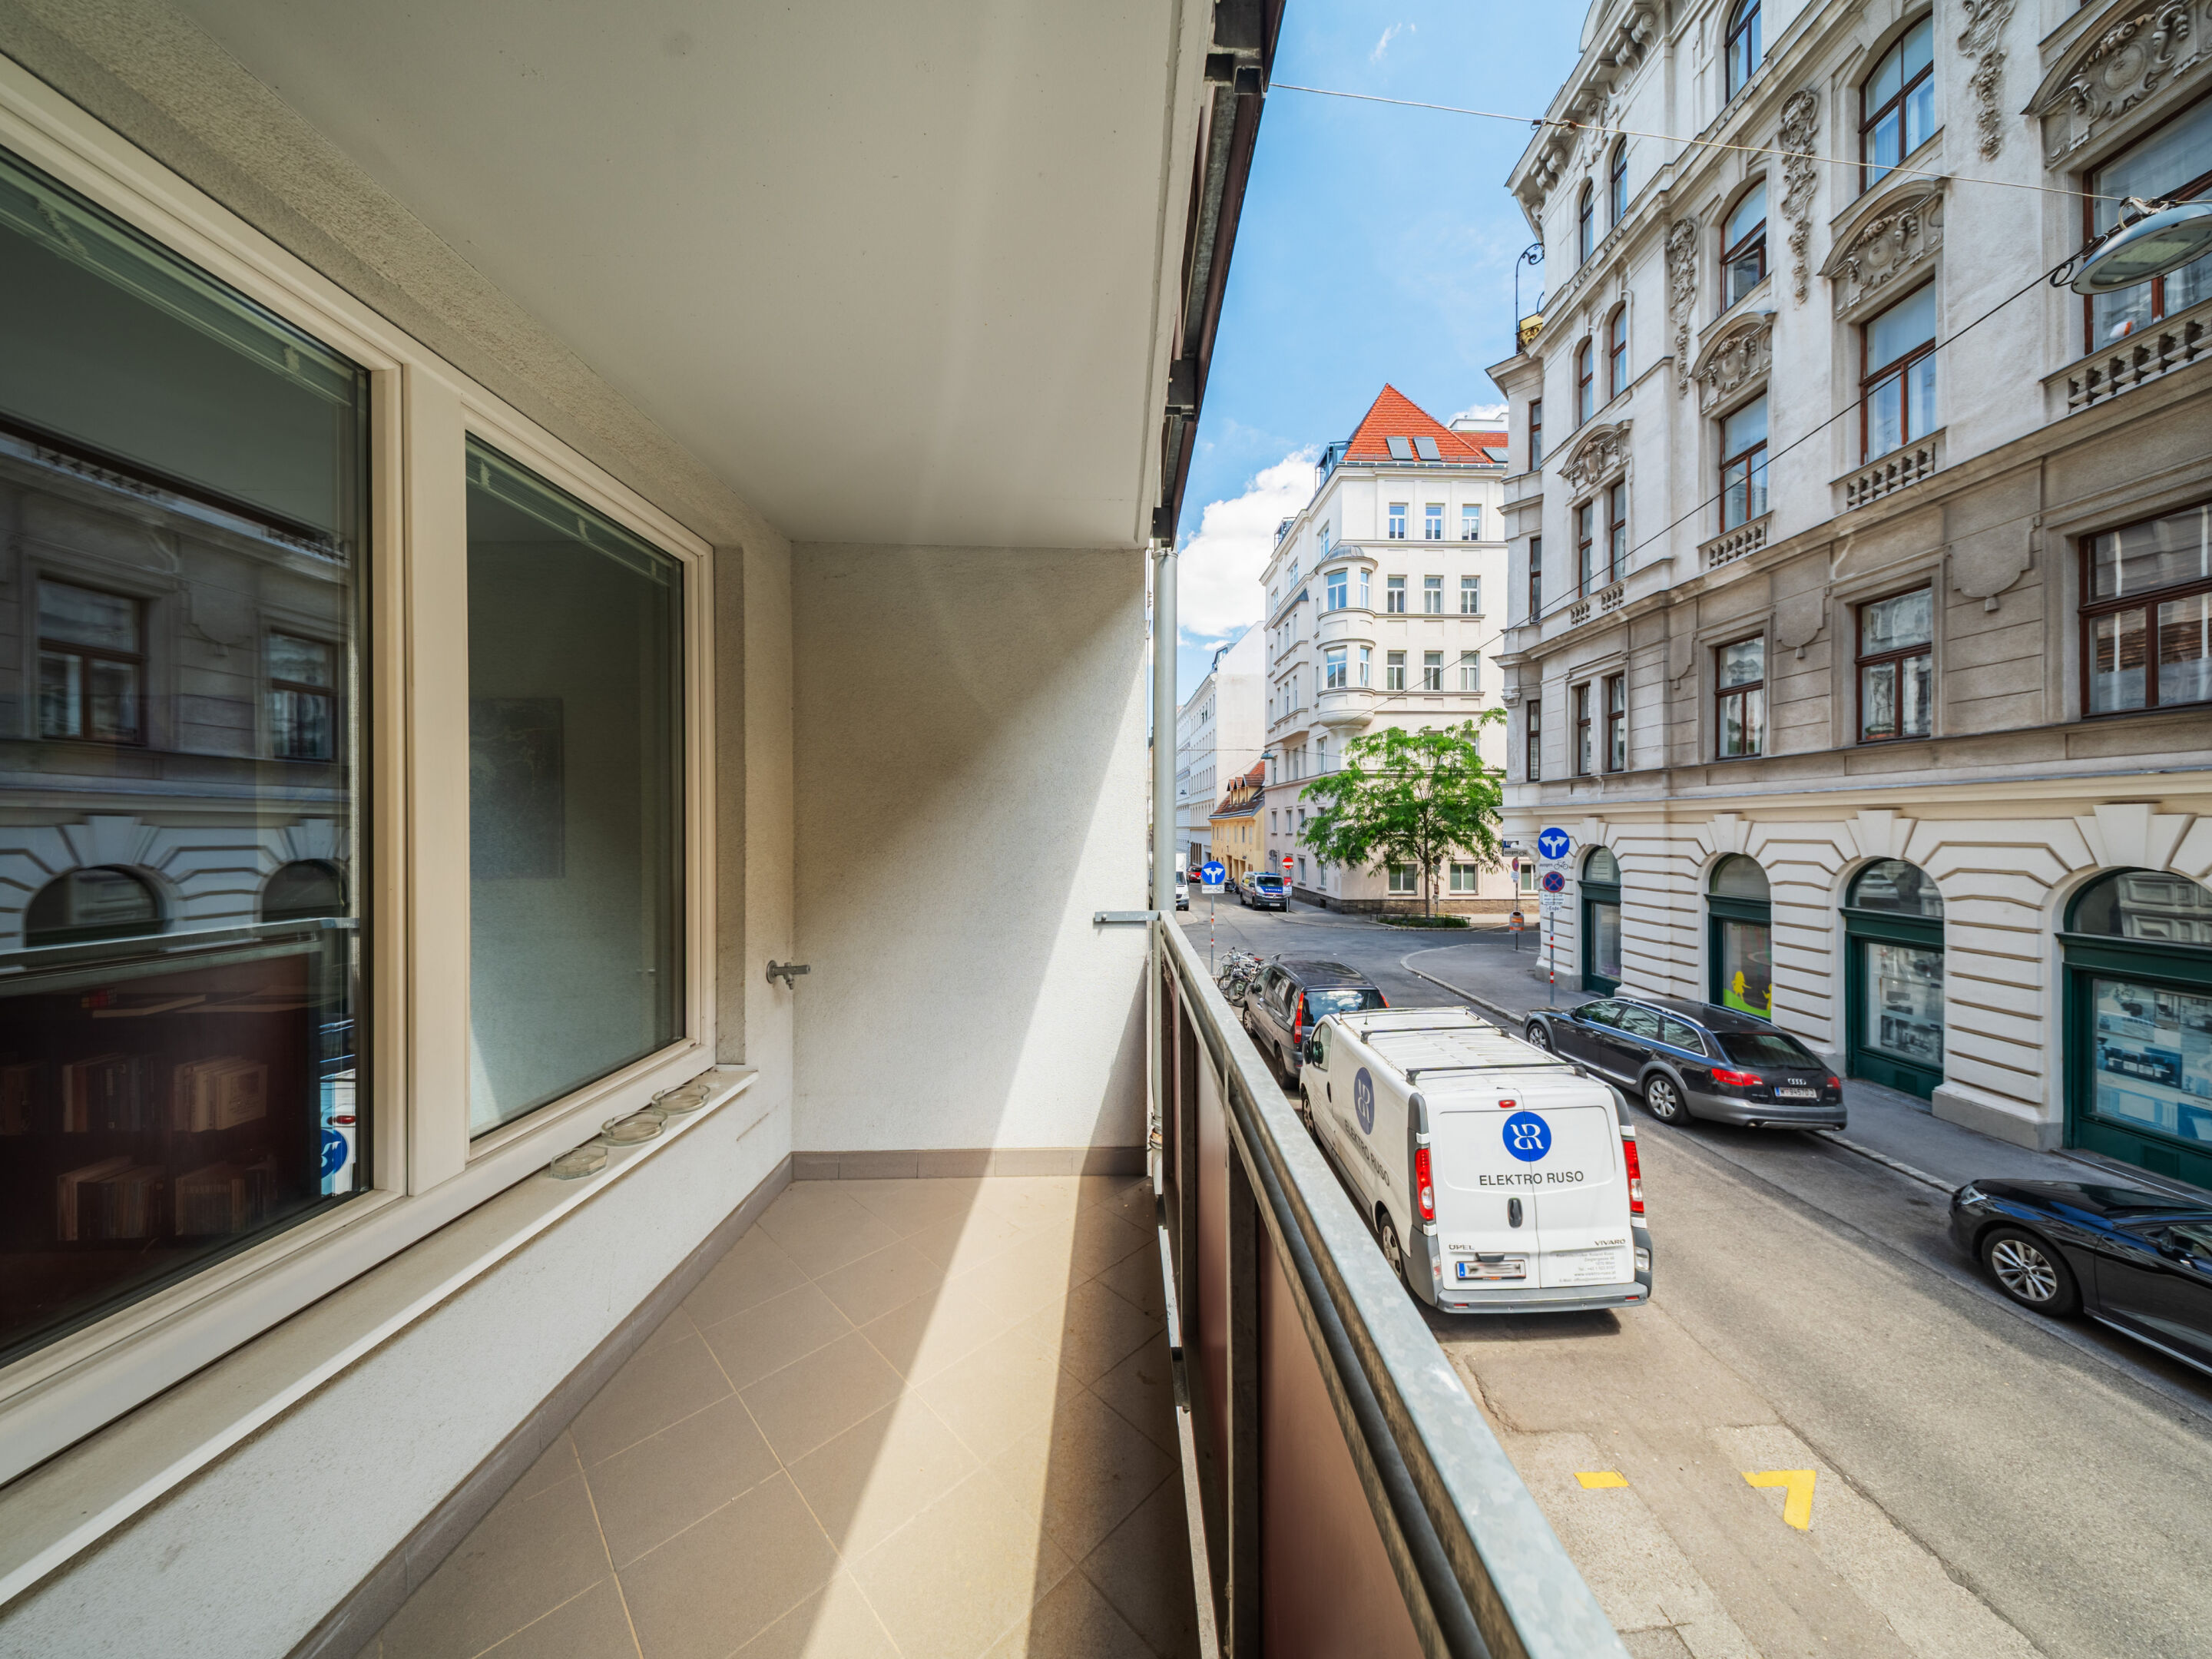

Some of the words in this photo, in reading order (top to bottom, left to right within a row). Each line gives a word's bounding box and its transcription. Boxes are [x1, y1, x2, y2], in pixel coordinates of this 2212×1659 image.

[1344, 1118, 1370, 1161] ELEKTRO
[1370, 1152, 1390, 1187] RUSO
[1479, 1173, 1542, 1186] ELEKTRO
[1546, 1171, 1584, 1184] RUSO
